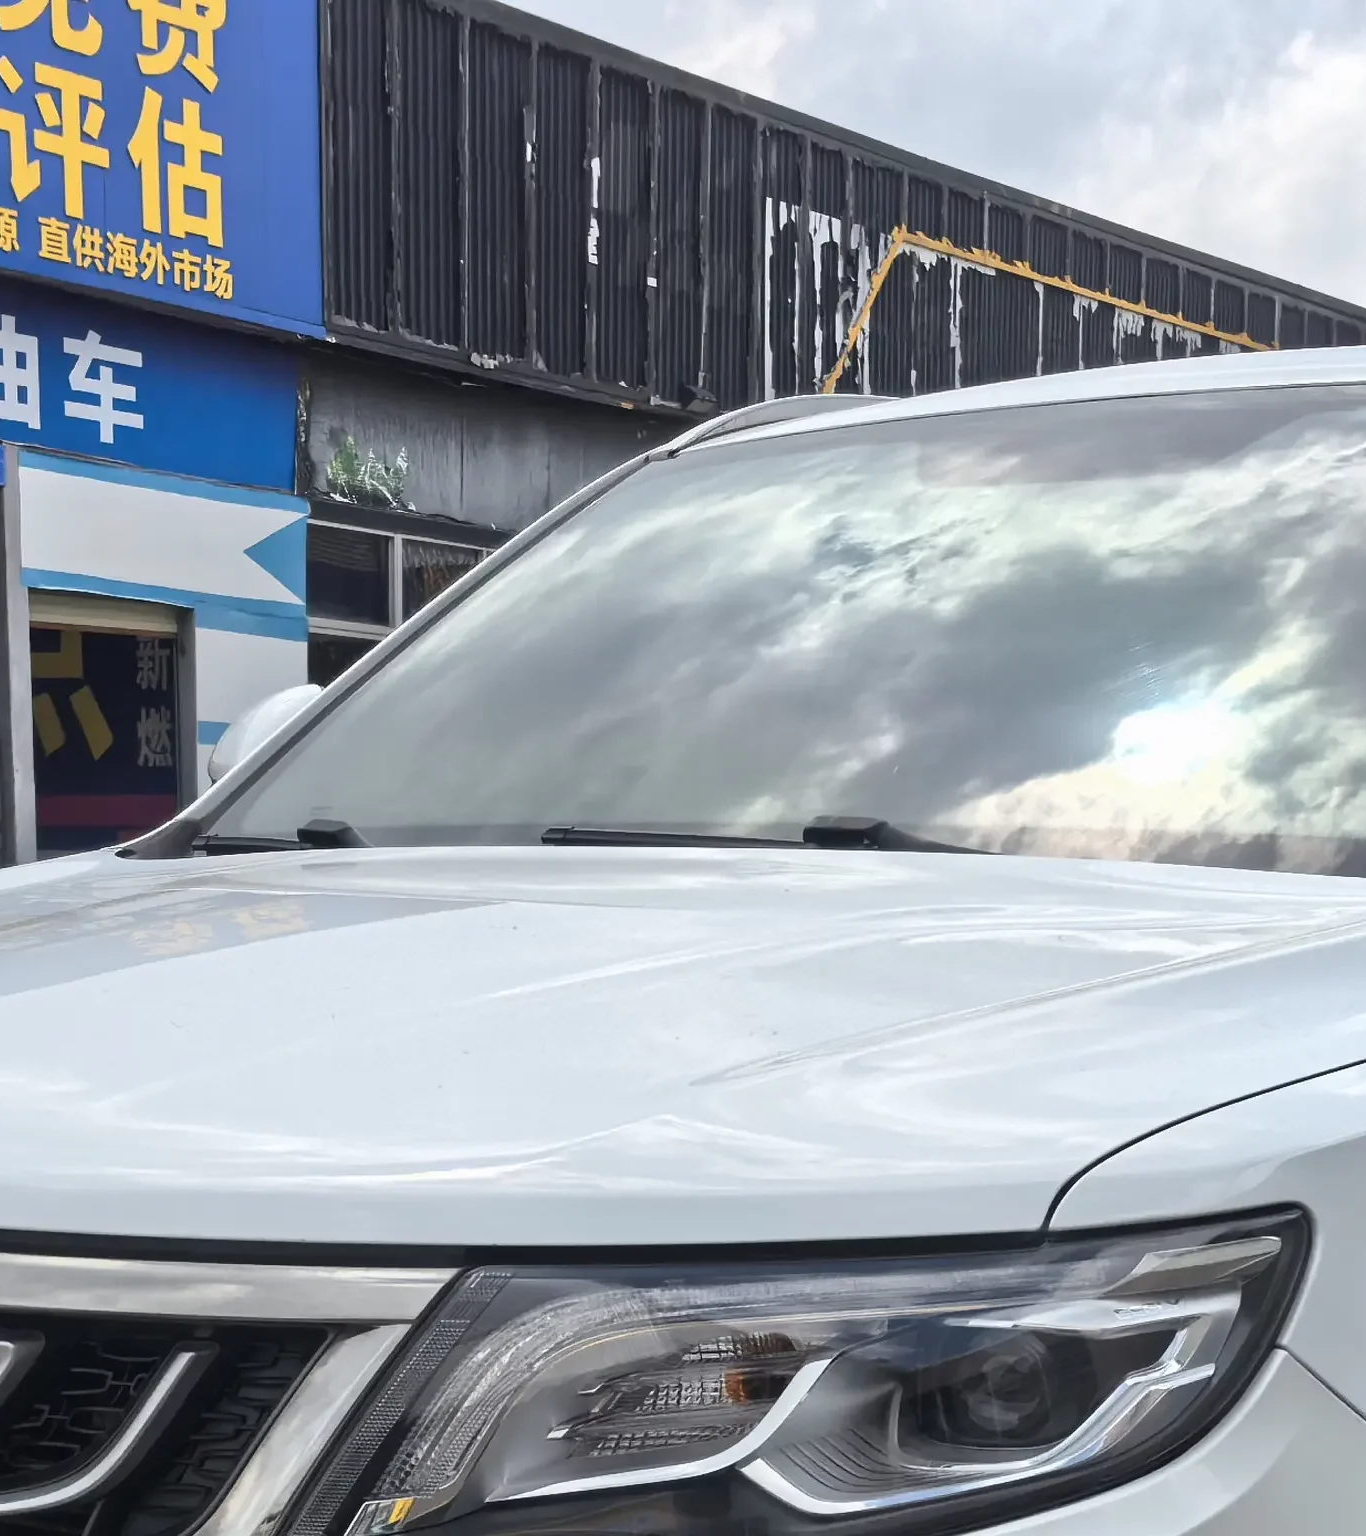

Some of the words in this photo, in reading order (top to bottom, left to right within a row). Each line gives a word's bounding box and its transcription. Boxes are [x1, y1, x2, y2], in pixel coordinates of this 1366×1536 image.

[38, 215, 235, 300] 直供海外市场
